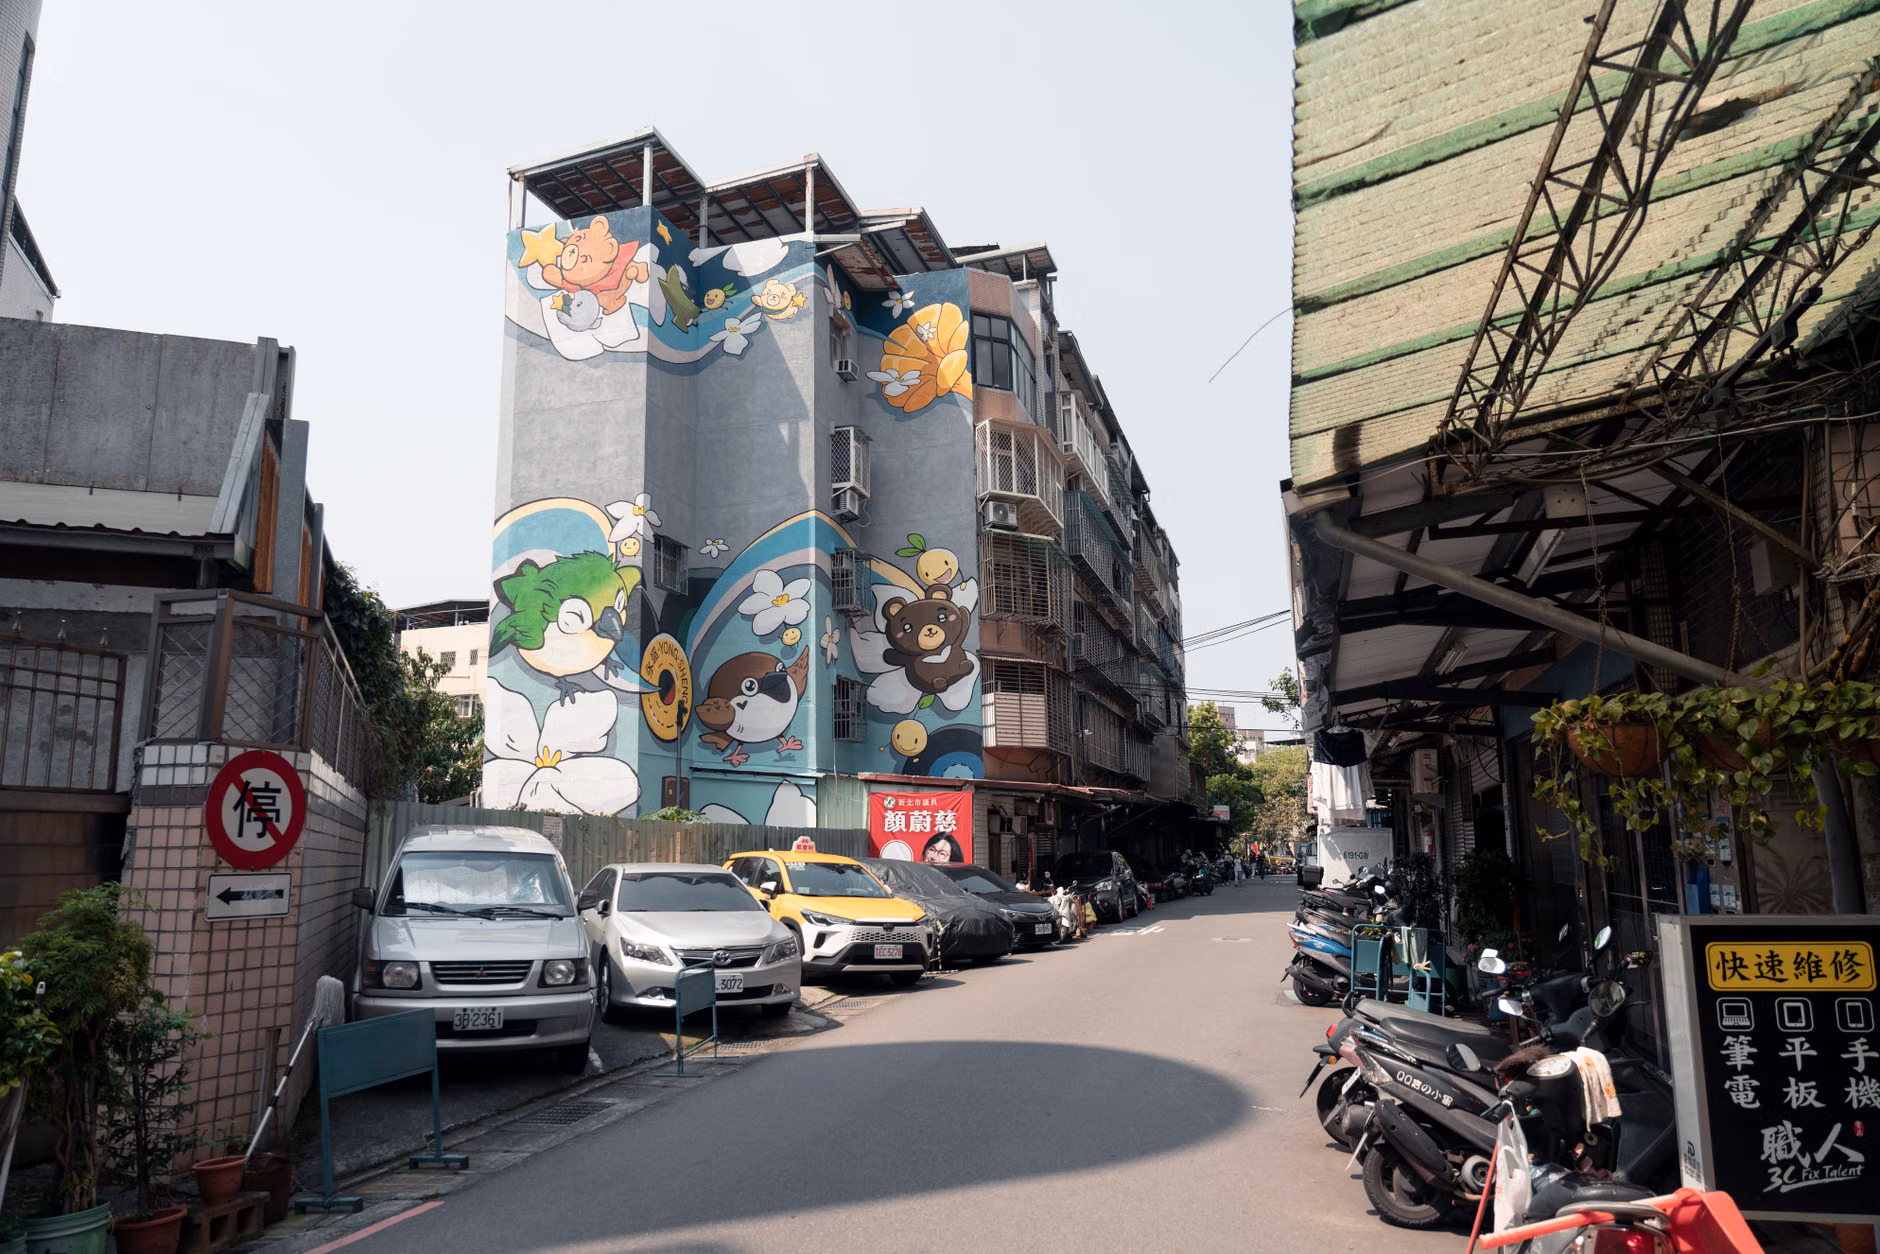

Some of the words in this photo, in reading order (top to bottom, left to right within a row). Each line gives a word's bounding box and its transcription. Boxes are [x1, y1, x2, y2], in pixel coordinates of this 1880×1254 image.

[233, 780, 281, 838] 停
[884, 810, 957, 832] 顏蔚慈
[898, 798, 937, 807] 新北市議員
[1715, 950, 1865, 983] 快速維修
[1720, 1035, 1761, 1109] 筆電
[1779, 1037, 1826, 1109] 平板
[1840, 1037, 1880, 1110] 手機
[1760, 1120, 1865, 1168] 職人
[1802, 1168, 1820, 1180] Fix
[1823, 1164, 1864, 1178] Talent
